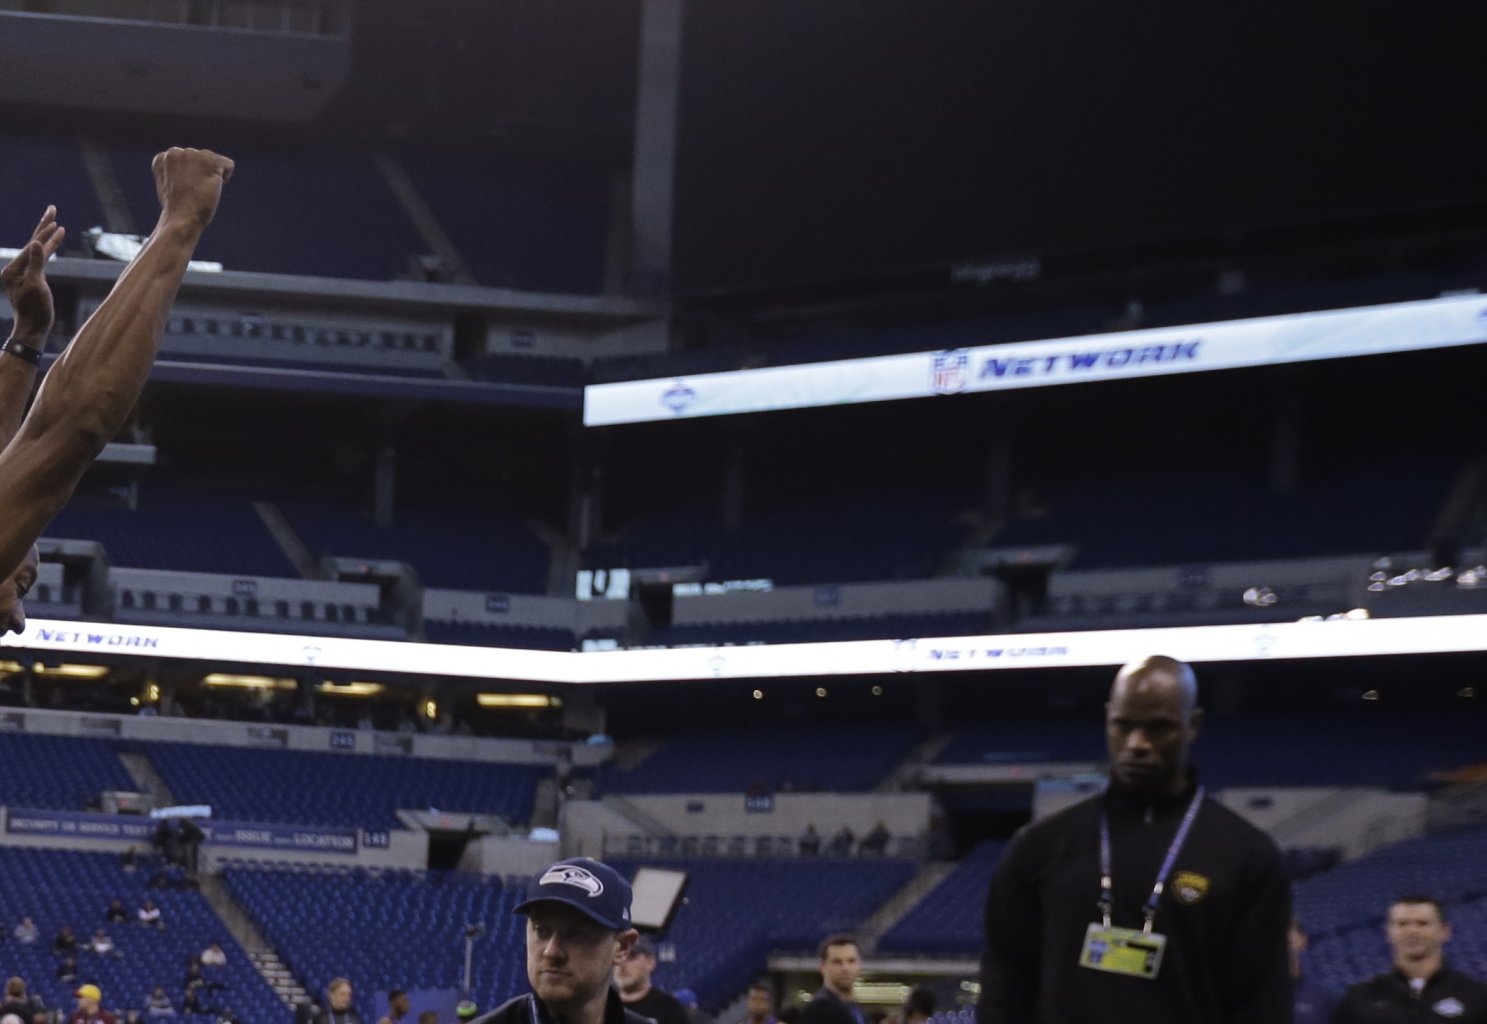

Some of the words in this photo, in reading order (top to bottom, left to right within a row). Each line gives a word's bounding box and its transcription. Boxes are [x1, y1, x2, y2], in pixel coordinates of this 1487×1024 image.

[979, 341, 1202, 379] NETWORK
[35, 628, 159, 648] NETWORK
[234, 829, 272, 843] ISSUE
[293, 832, 354, 848] LOCATION
